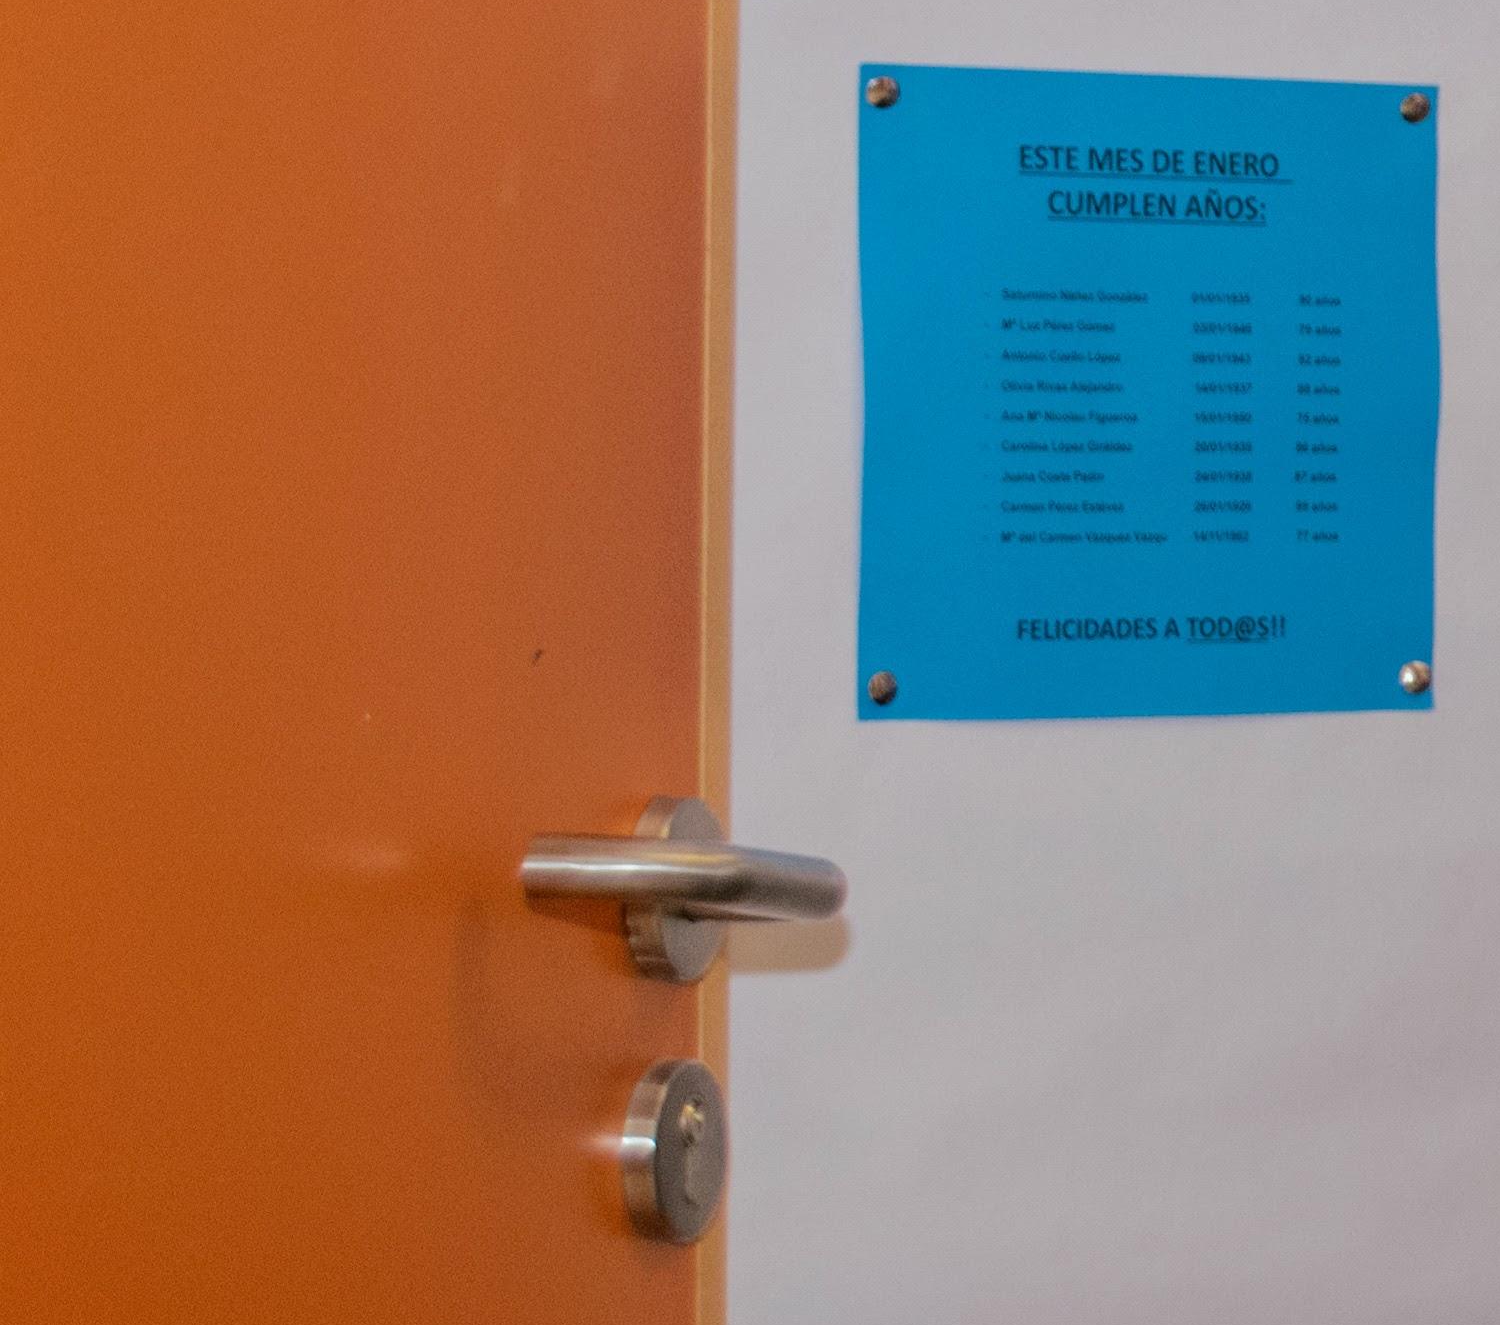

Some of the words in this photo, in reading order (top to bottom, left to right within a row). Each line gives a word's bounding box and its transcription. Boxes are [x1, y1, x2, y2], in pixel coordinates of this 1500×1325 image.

[1019, 144, 1079, 172] ESTE
[1088, 146, 1144, 174] MES
[1152, 149, 1184, 175] DE
[1194, 150, 1279, 178] ENERO
[1048, 189, 1176, 218] CUMPLEN
[1185, 188, 1266, 221] AÑOS:
[1314, 295, 1341, 307] años
[1018, 319, 1040, 331] Luz
[1313, 324, 1342, 336] años
[1000, 350, 1046, 362] Antonio
[1313, 354, 1341, 366] años
[1312, 384, 1341, 395] años
[1000, 410, 1024, 422] Ana
[1312, 413, 1339, 425] años
[1310, 442, 1338, 454] años
[1001, 471, 1036, 482] Juana
[1309, 471, 1337, 483] años
[1000, 501, 1045, 512] Carmen
[1310, 501, 1338, 512] años
[1037, 531, 1081, 543] Carmen
[1311, 530, 1339, 542] años
[1017, 618, 1157, 641] FELICIDADES
[1164, 617, 1180, 639] A
[1187, 614, 1286, 642] TOD@S!!
